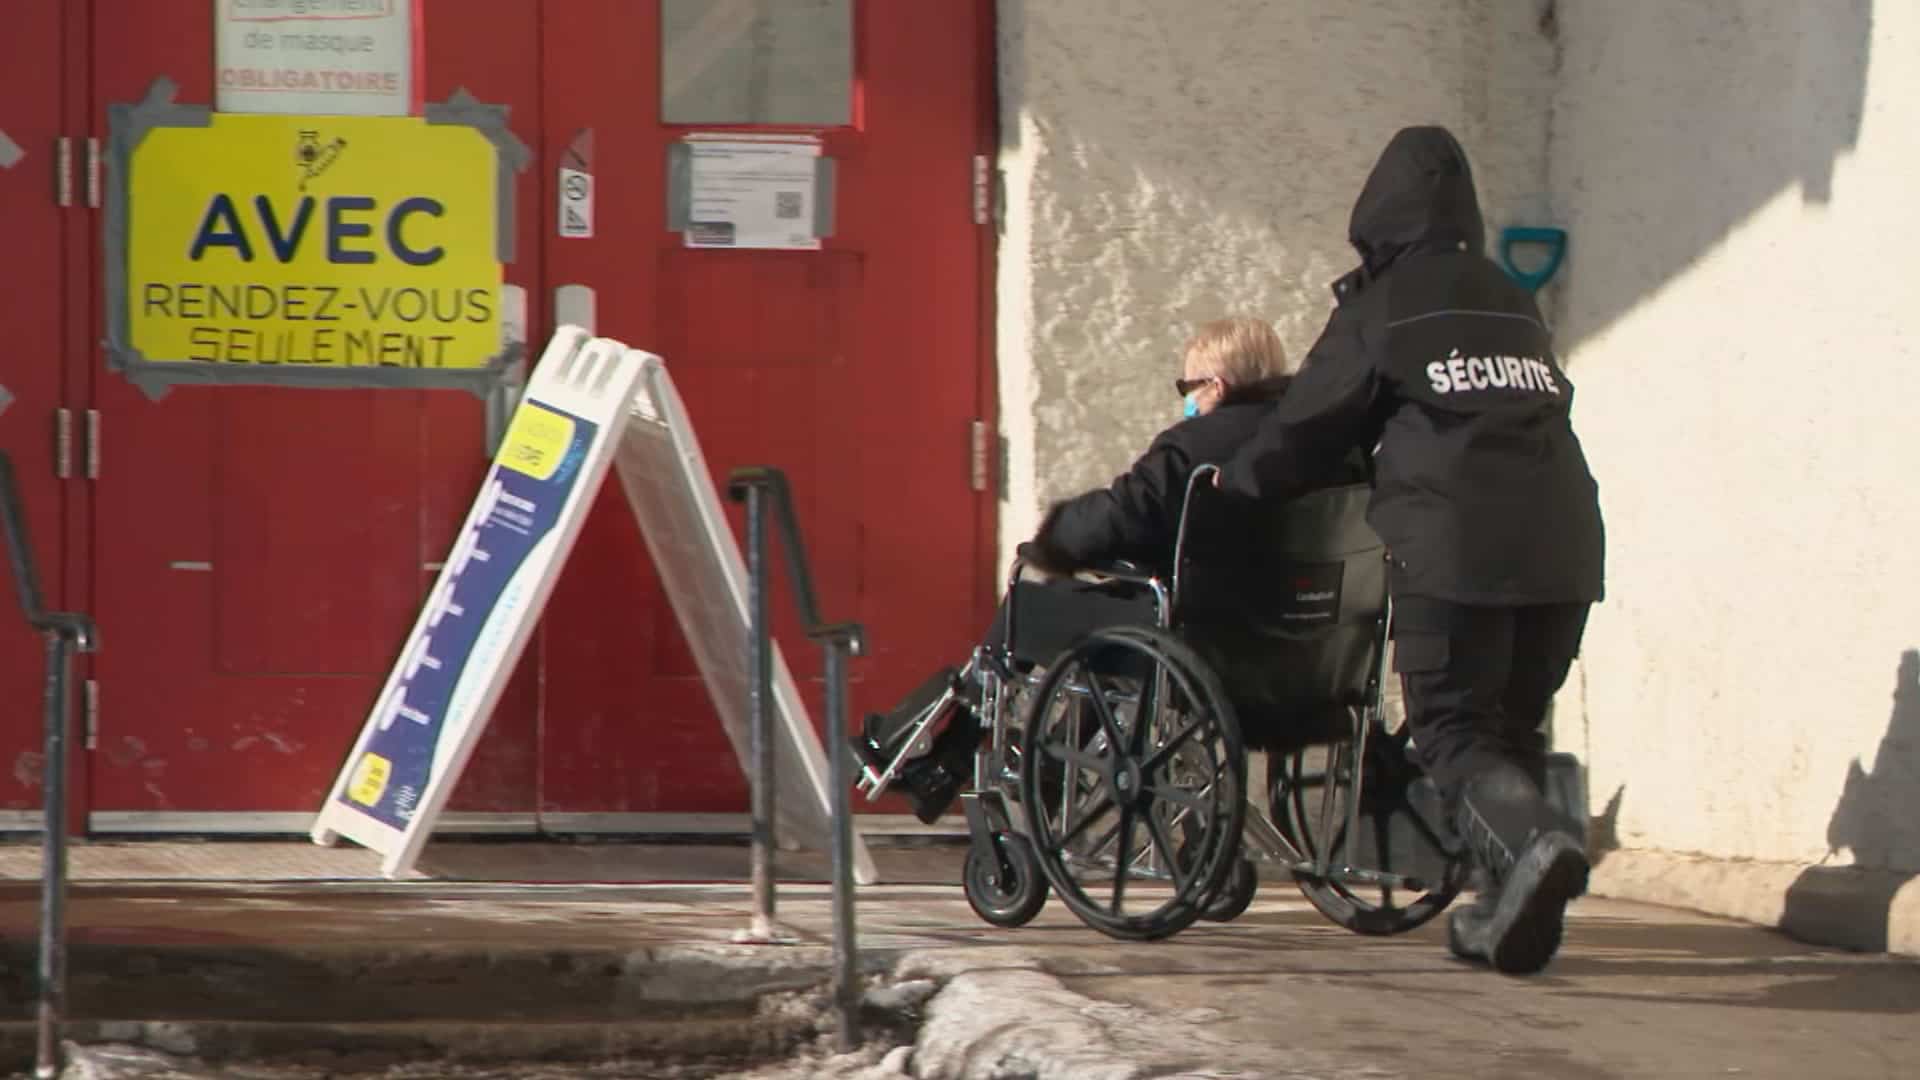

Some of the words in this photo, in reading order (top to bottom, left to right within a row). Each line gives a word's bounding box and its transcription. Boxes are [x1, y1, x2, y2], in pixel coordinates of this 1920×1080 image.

[244, 29, 273, 50] de
[280, 34, 374, 56] masque
[221, 68, 398, 91] OBLIGATOIRE
[189, 194, 446, 265] AVEC
[143, 283, 491, 323] RENDEZ-VOUS
[189, 327, 454, 368] SEULEMENT
[1426, 347, 1560, 395] SÉCURITÉ
